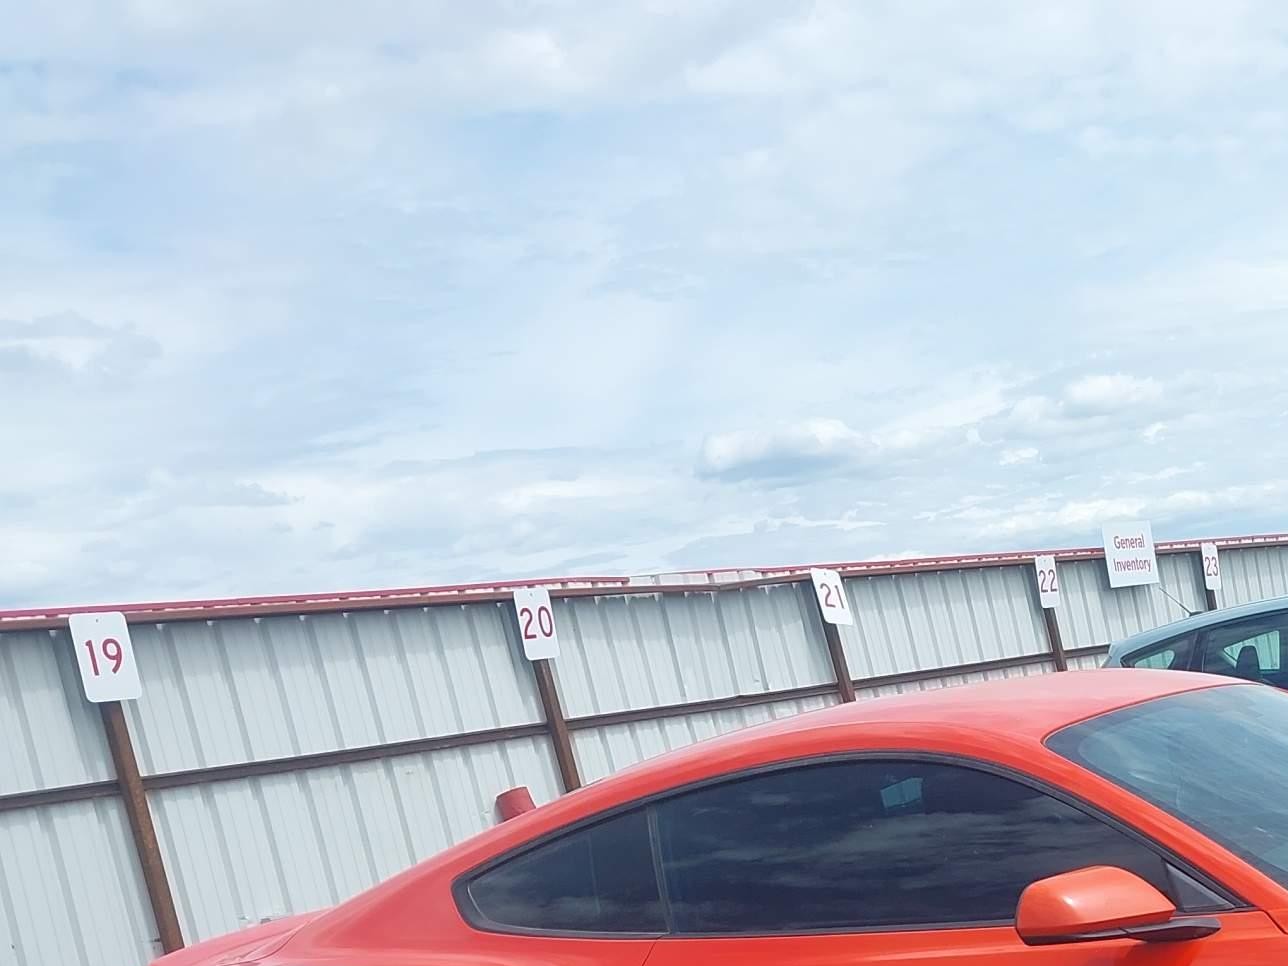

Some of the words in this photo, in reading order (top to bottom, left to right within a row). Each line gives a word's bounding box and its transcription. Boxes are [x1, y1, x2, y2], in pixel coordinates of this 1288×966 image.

[1113, 533, 1146, 549] General
[1113, 556, 1151, 572] Inventory
[1205, 556, 1218, 576] 23
[1038, 569, 1058, 592] 22
[820, 583, 845, 609] 21
[520, 606, 553, 639] 20
[85, 638, 122, 676] 19
